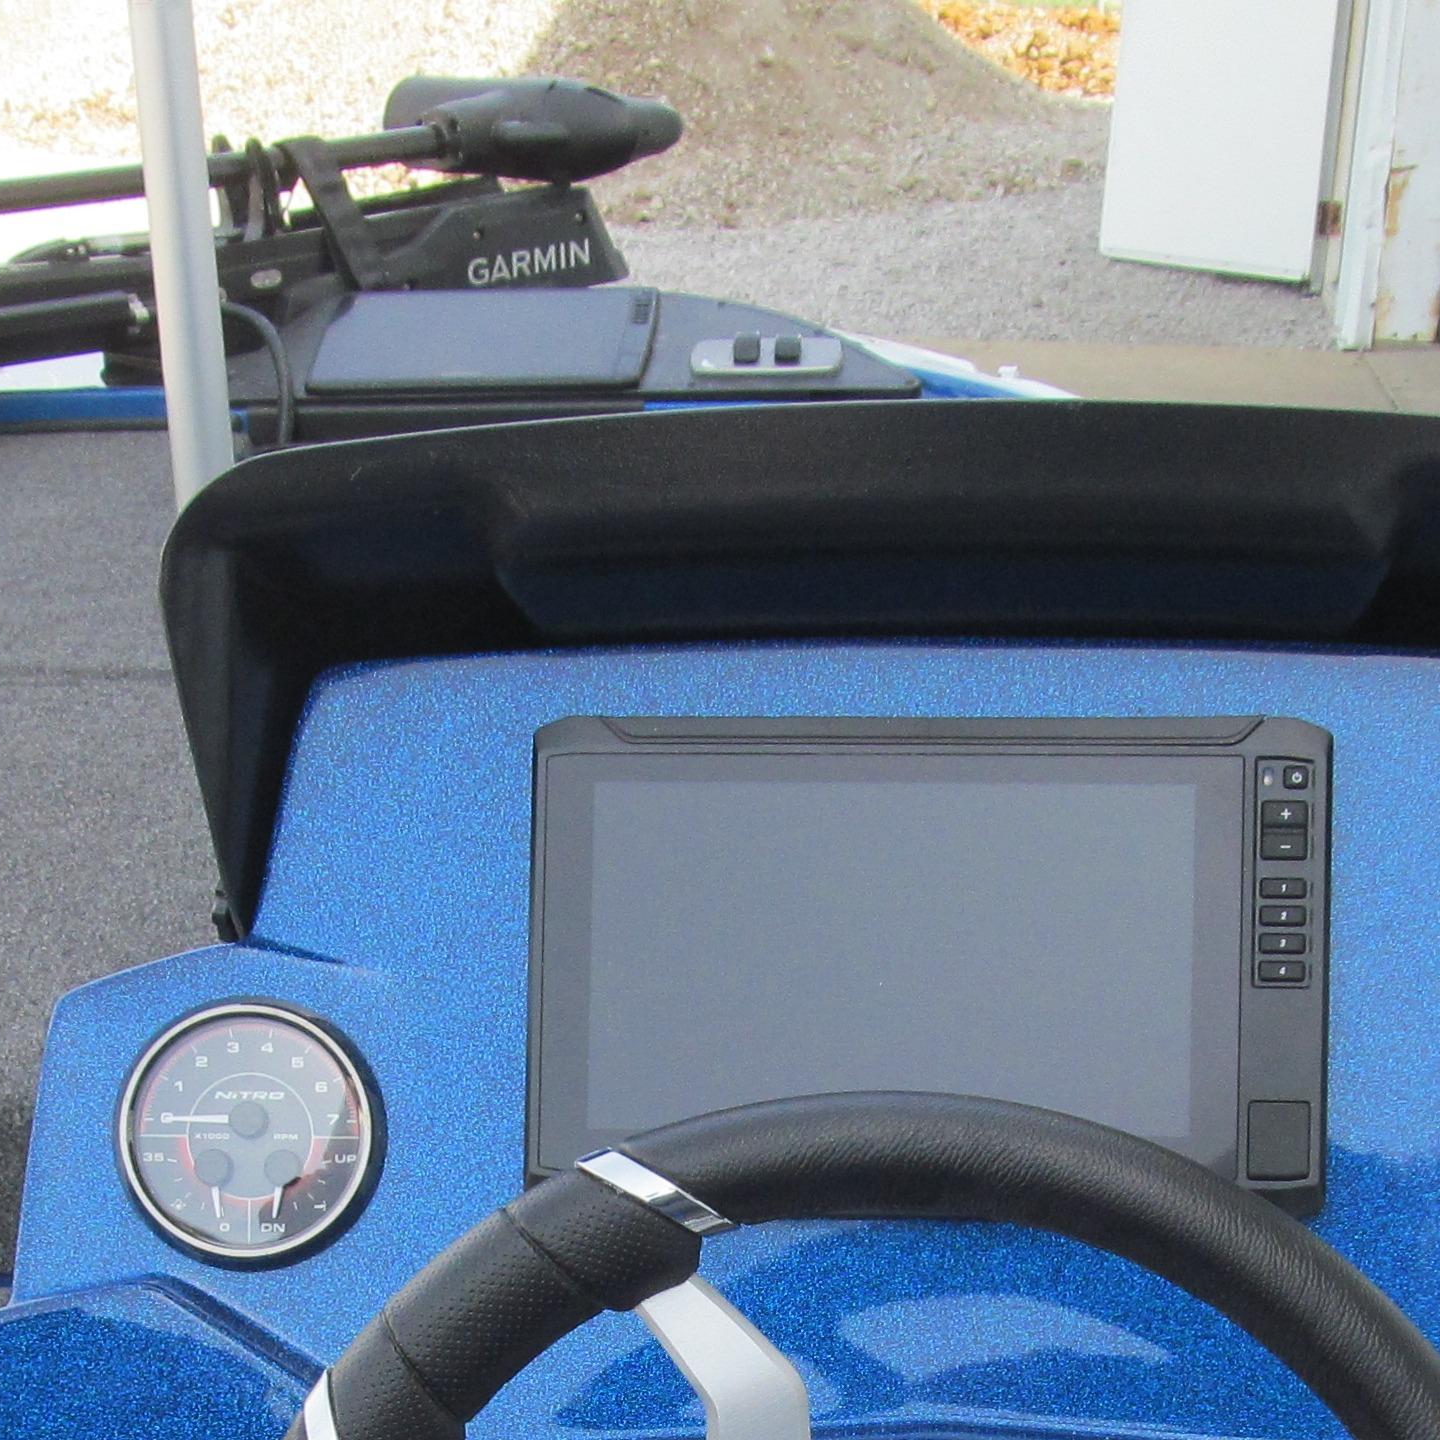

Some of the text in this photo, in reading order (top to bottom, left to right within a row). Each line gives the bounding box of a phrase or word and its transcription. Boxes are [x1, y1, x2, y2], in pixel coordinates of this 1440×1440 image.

[467, 237, 591, 286] GARMIN
[226, 1042, 240, 1053] 3
[261, 1042, 274, 1053] 4
[195, 1056, 209, 1068] 2
[291, 1057, 304, 1068] 5
[174, 1081, 184, 1092] 1
[315, 1082, 328, 1093] 6
[327, 1114, 340, 1125] 7
[273, 1133, 299, 1141] RPM
[143, 1152, 164, 1162] 35
[334, 1153, 357, 1164] UP
[219, 1223, 231, 1233] 0
[261, 1223, 286, 1233] DN
